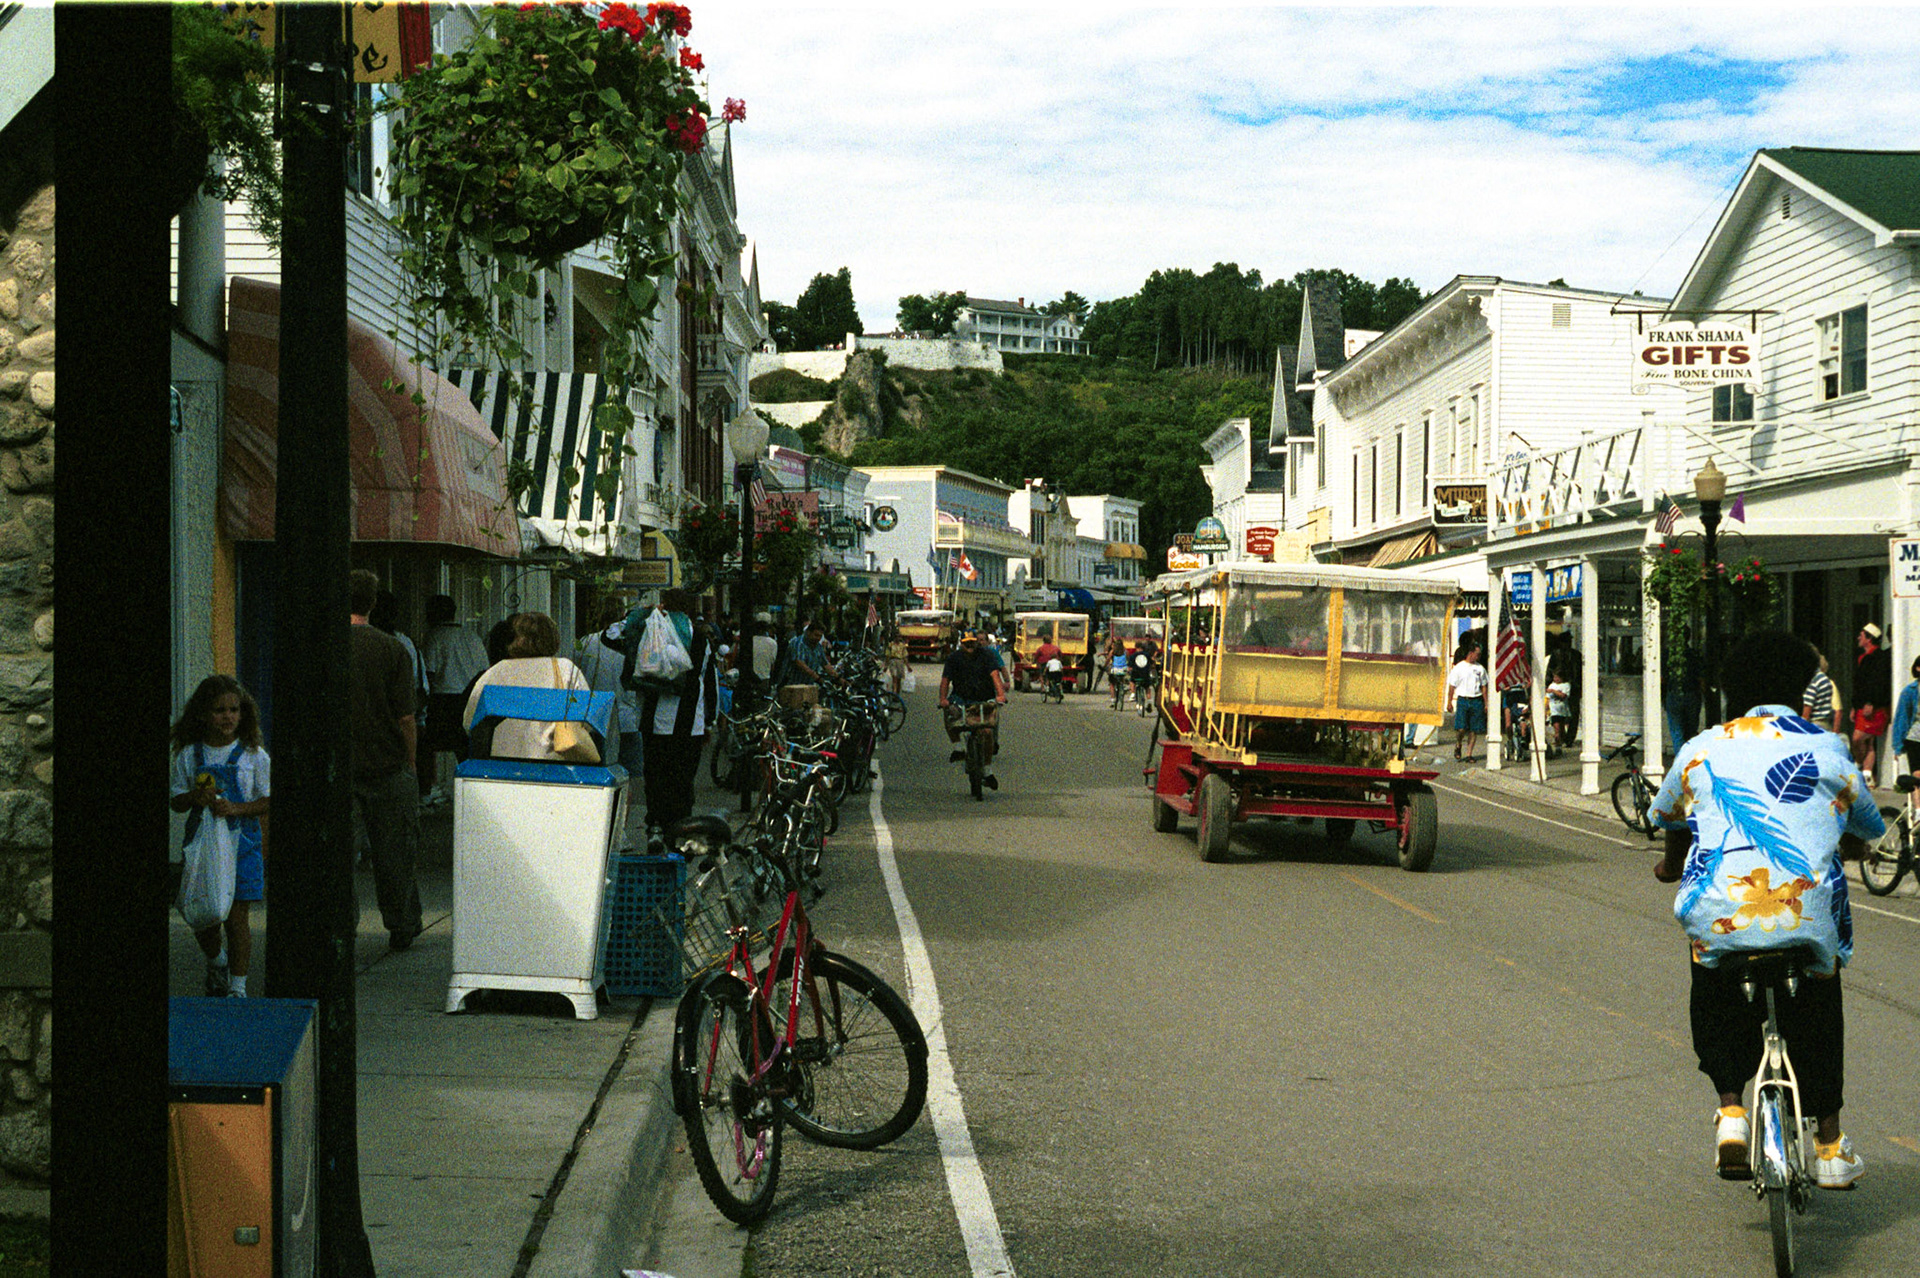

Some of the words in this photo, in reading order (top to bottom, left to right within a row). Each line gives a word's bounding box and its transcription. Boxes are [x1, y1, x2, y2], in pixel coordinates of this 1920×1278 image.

[1649, 331, 1694, 342] FRANK
[1697, 331, 1744, 342] SHAMA
[1641, 346, 1751, 365] GIFTS
[1674, 369, 1709, 379] BONE
[1712, 369, 1752, 379] CHINA
[1436, 487, 1487, 508] MURDI
[1192, 543, 1229, 551] HAMBURGERS
[1169, 560, 1200, 569] Kodak
